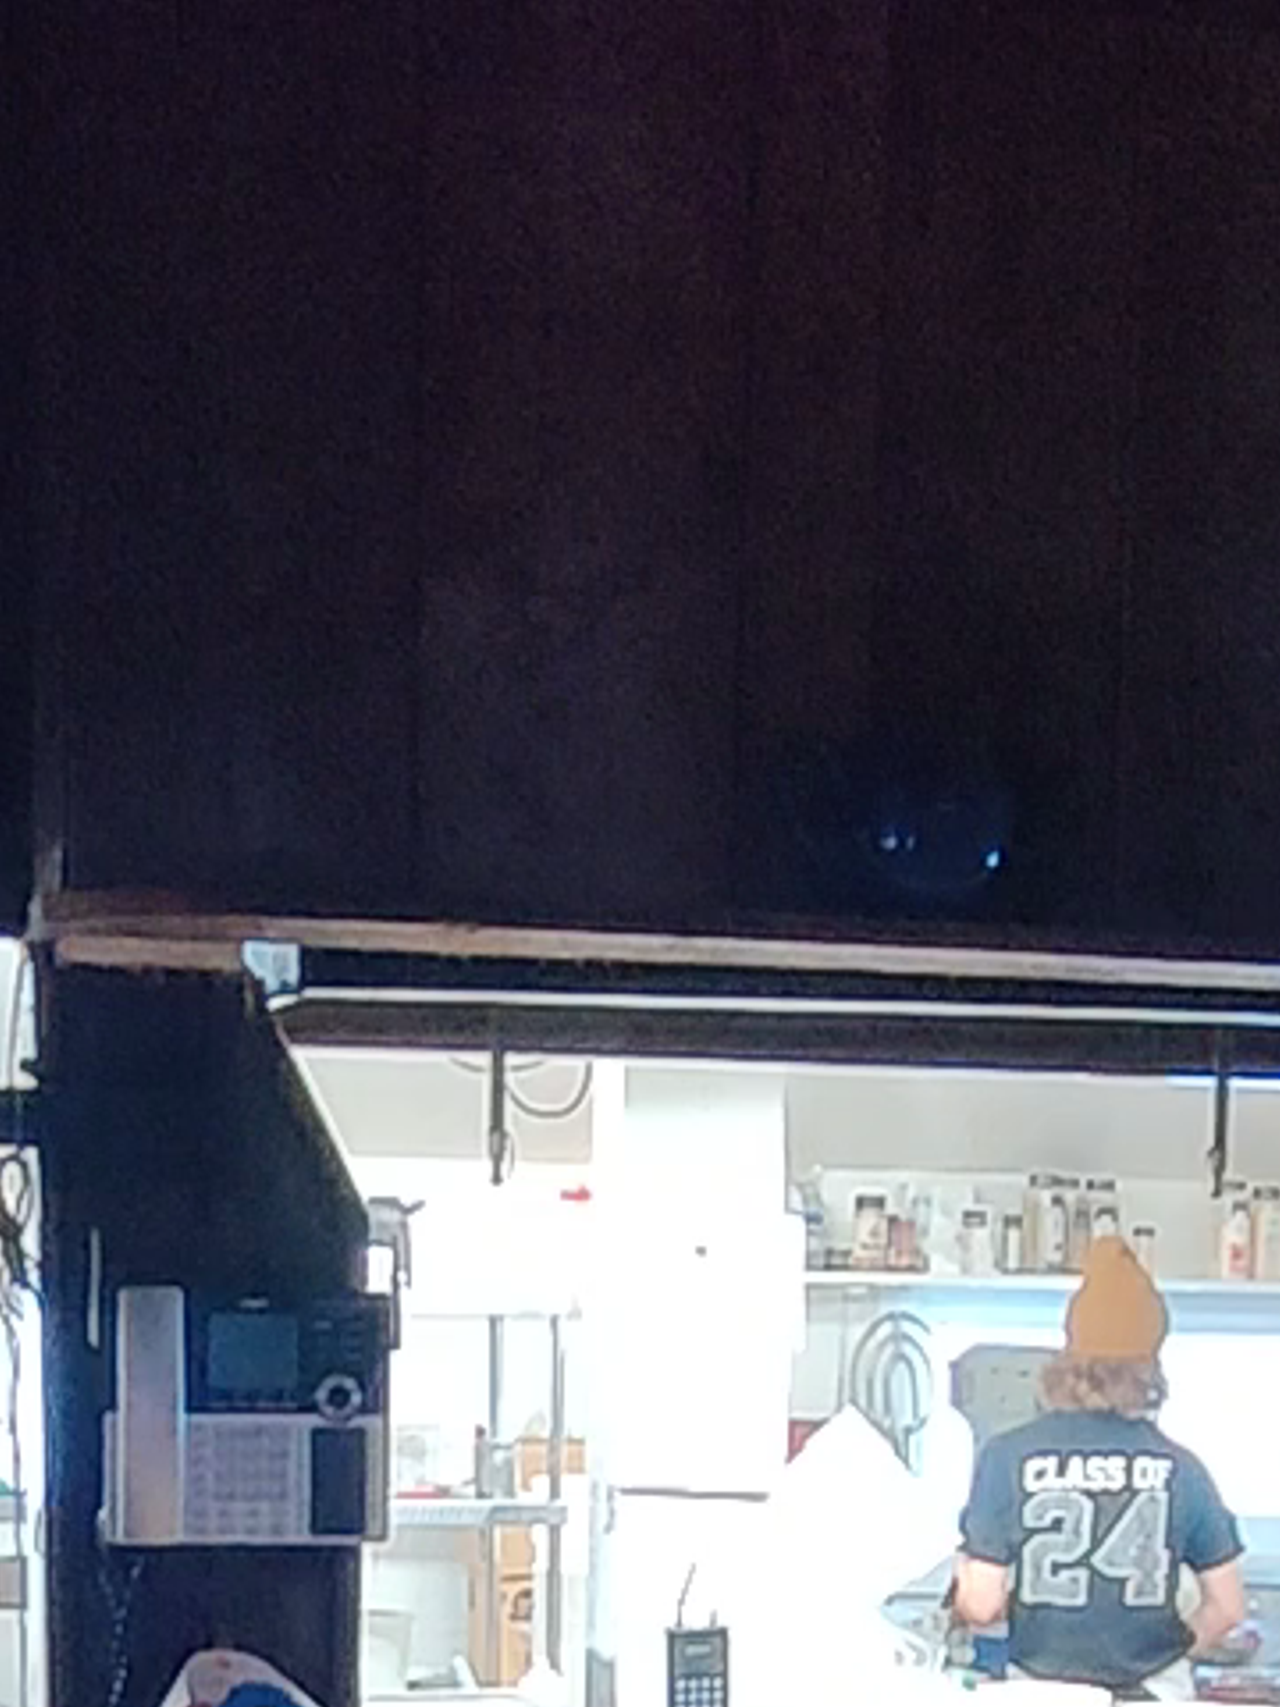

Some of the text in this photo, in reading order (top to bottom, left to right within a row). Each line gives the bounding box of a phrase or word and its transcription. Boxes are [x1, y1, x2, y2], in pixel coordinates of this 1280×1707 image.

[1023, 1455, 1173, 1492] CLASS OF
[1020, 1491, 1171, 1607] 24
